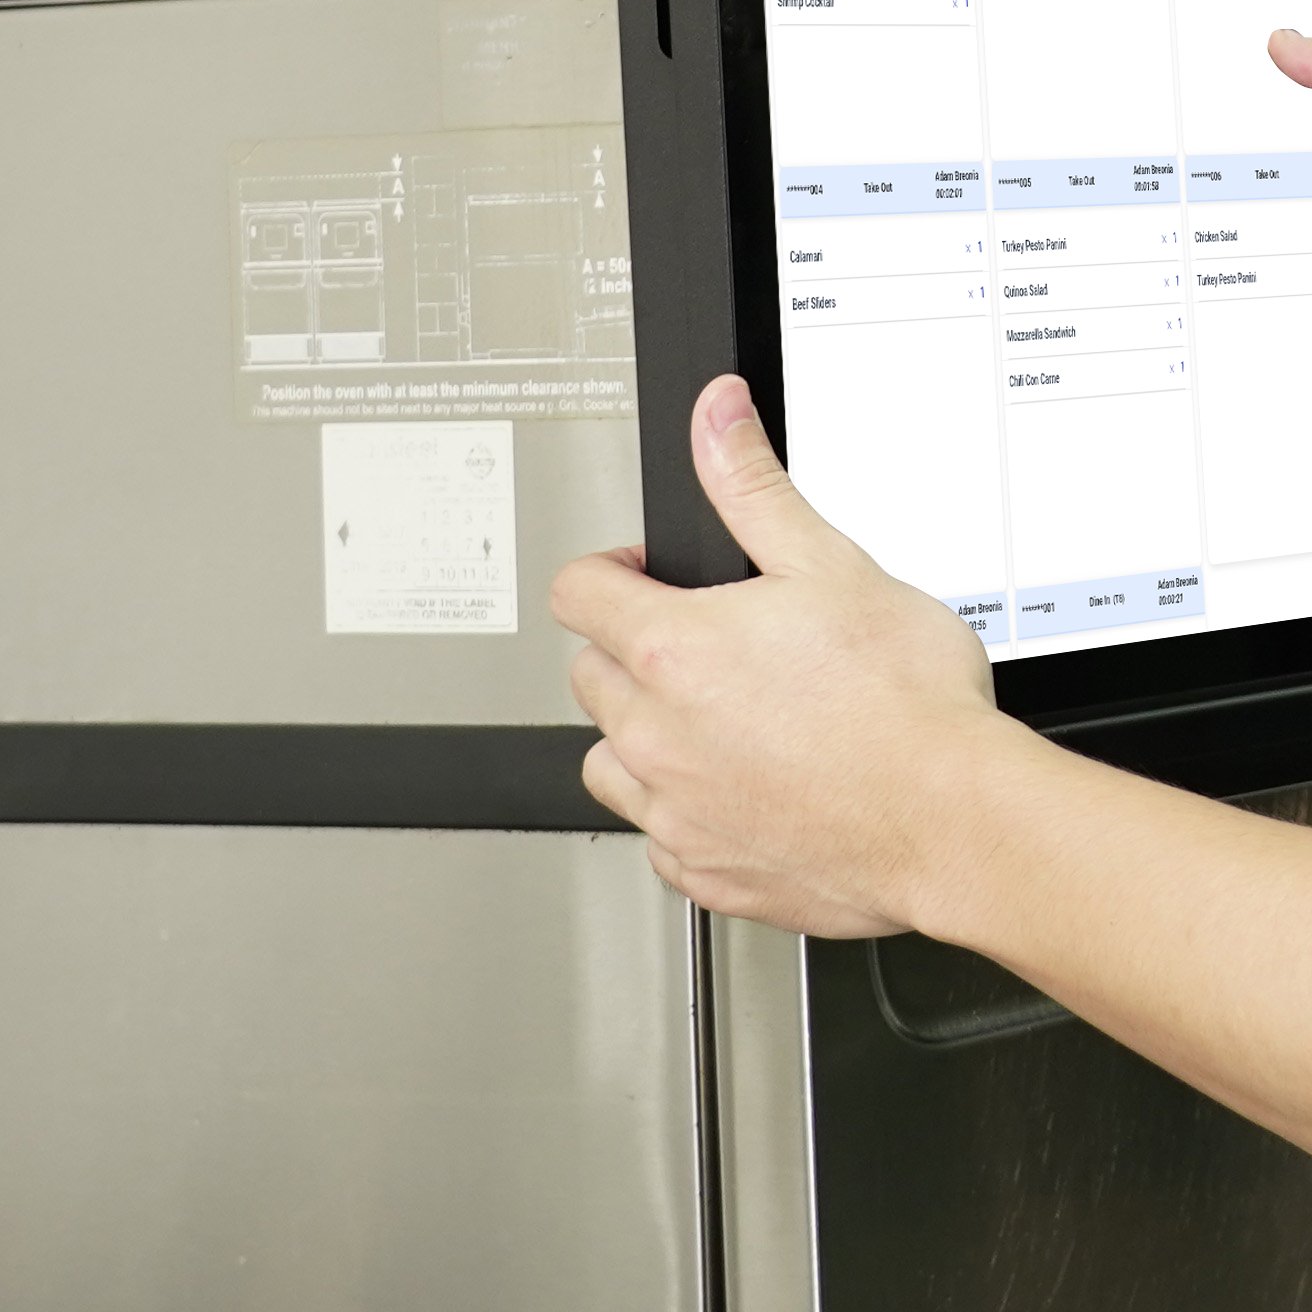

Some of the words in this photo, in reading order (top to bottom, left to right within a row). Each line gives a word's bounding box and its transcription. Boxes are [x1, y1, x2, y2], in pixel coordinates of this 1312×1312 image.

[935, 171, 953, 181] Adam
[1133, 165, 1150, 174] Adam
[1255, 169, 1268, 179] Take
[1269, 170, 1279, 179] Out
[594, 169, 605, 186] A
[1068, 175, 1083, 186] Take
[1084, 176, 1095, 185] Out
[393, 178, 404, 195] A
[864, 182, 879, 193] Take
[881, 182, 893, 192] Out
[1195, 231, 1219, 243] Chicken
[1220, 230, 1237, 241] Salad
[1002, 240, 1024, 254] Turkey
[1025, 240, 1044, 251] Pesto
[1046, 238, 1067, 250] Panini
[790, 250, 823, 263] Calamari
[583, 258, 593, 274] A
[1197, 274, 1218, 288] Turkey
[1219, 273, 1236, 284] Pesto
[1237, 272, 1256, 283] Panini
[1004, 286, 1028, 298] Quinoa
[1029, 284, 1048, 296] Salad
[792, 297, 809, 310] Beef
[811, 297, 836, 309] Sliders
[1007, 328, 1043, 342] Mozzarella
[1044, 326, 1075, 339] Sandwich
[1009, 375, 1024, 387] Chili
[1025, 374, 1039, 386] Con
[1040, 373, 1060, 384] Carne
[263, 384, 311, 400] Position
[314, 384, 331, 399] the
[335, 385, 363, 399] oven
[367, 383, 391, 399] with
[395, 383, 406, 398] at
[410, 382, 437, 398] least
[441, 381, 459, 397] the
[463, 381, 518, 396] minimum
[522, 379, 580, 396] clearance
[584, 379, 627, 394] shown.
[1158, 579, 1175, 590] Adam
[958, 605, 976, 616] Adam
